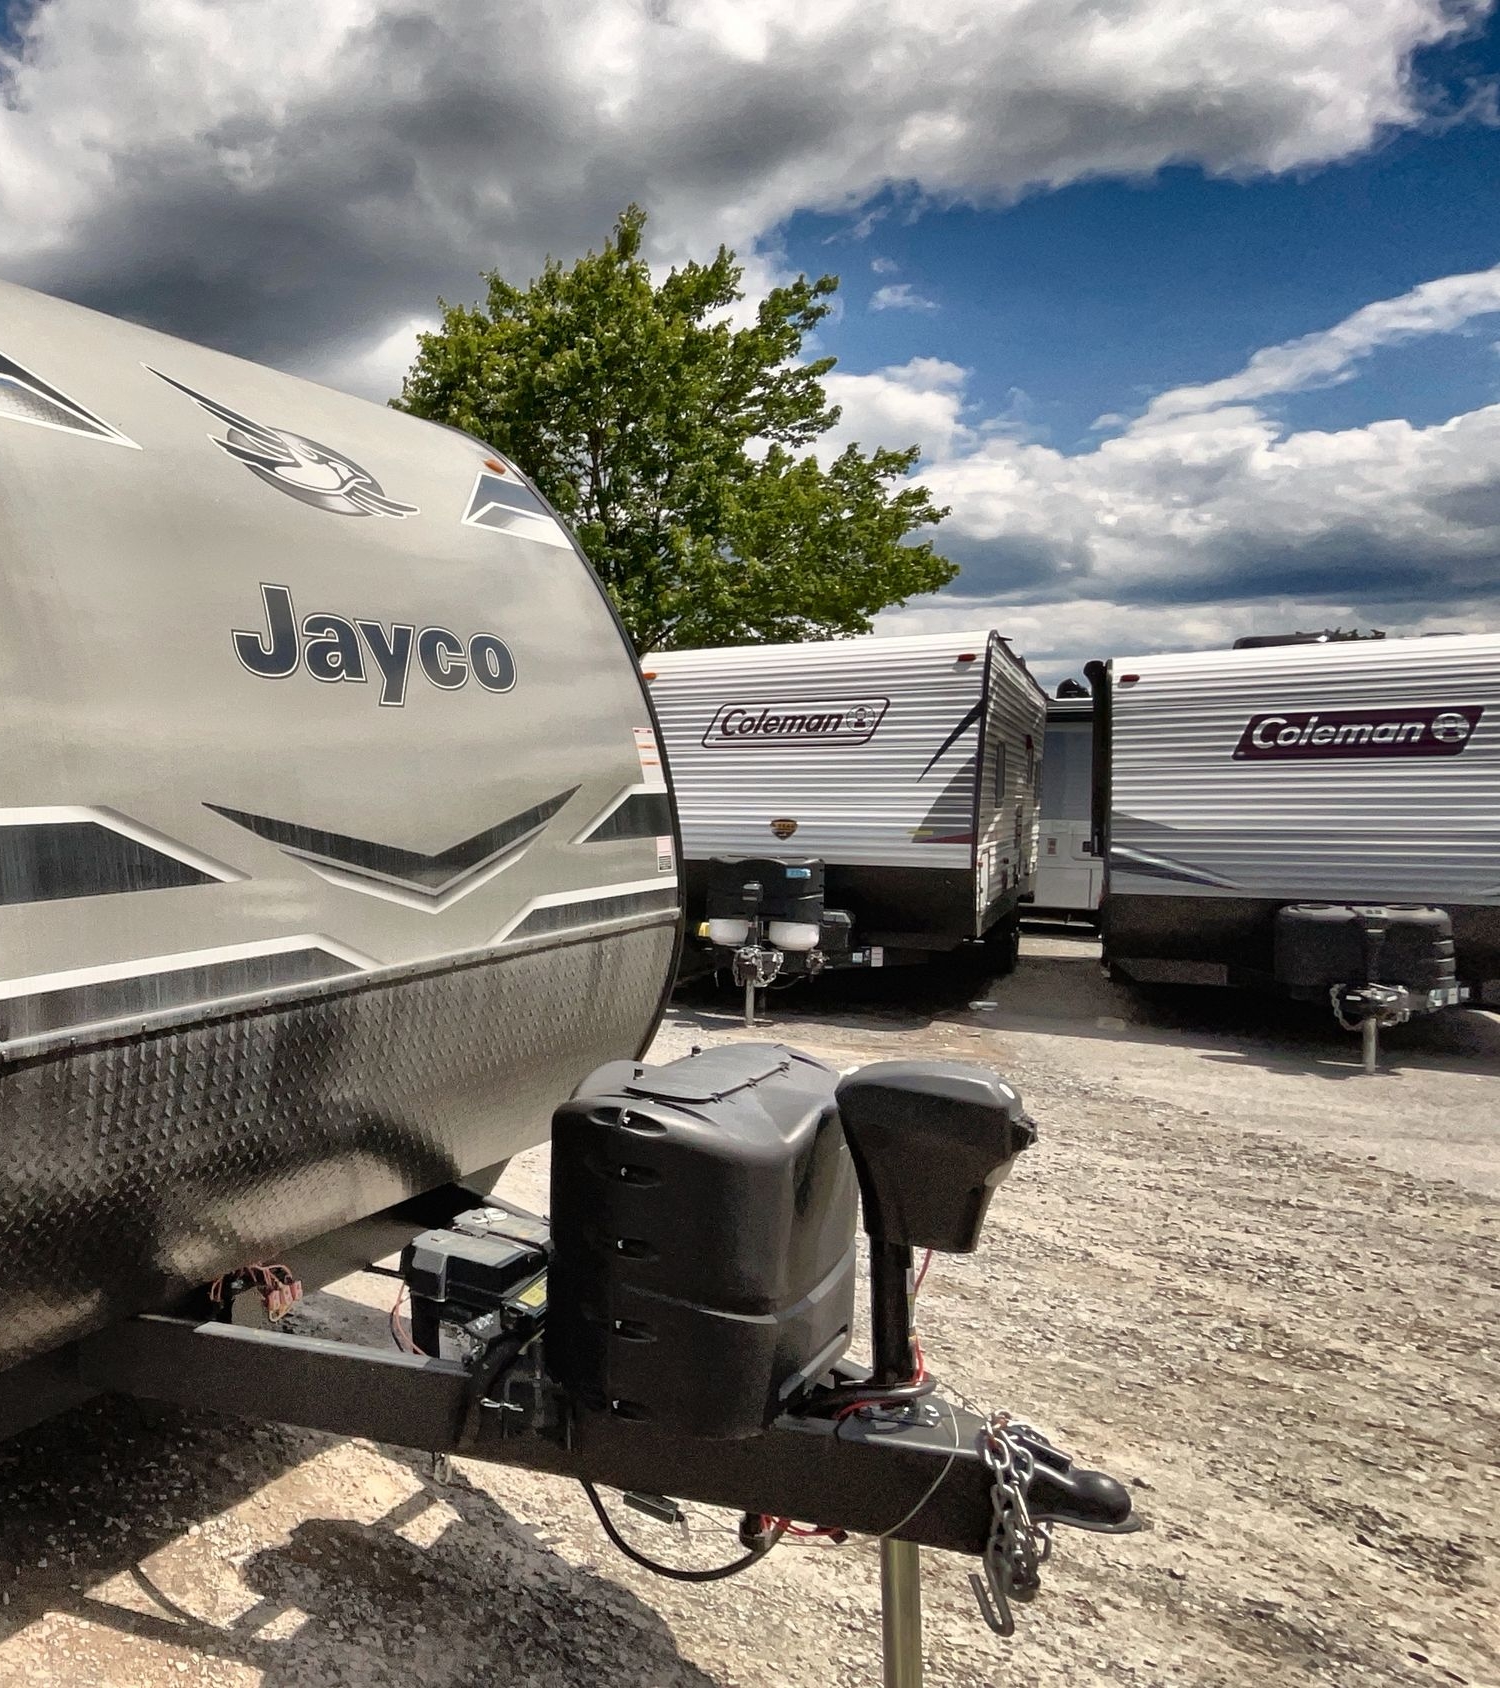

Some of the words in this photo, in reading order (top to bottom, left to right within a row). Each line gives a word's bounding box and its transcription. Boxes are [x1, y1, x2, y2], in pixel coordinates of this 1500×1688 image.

[231, 582, 517, 707] Jayco
[720, 708, 844, 736] Coleman
[1252, 716, 1426, 749] Coleman
